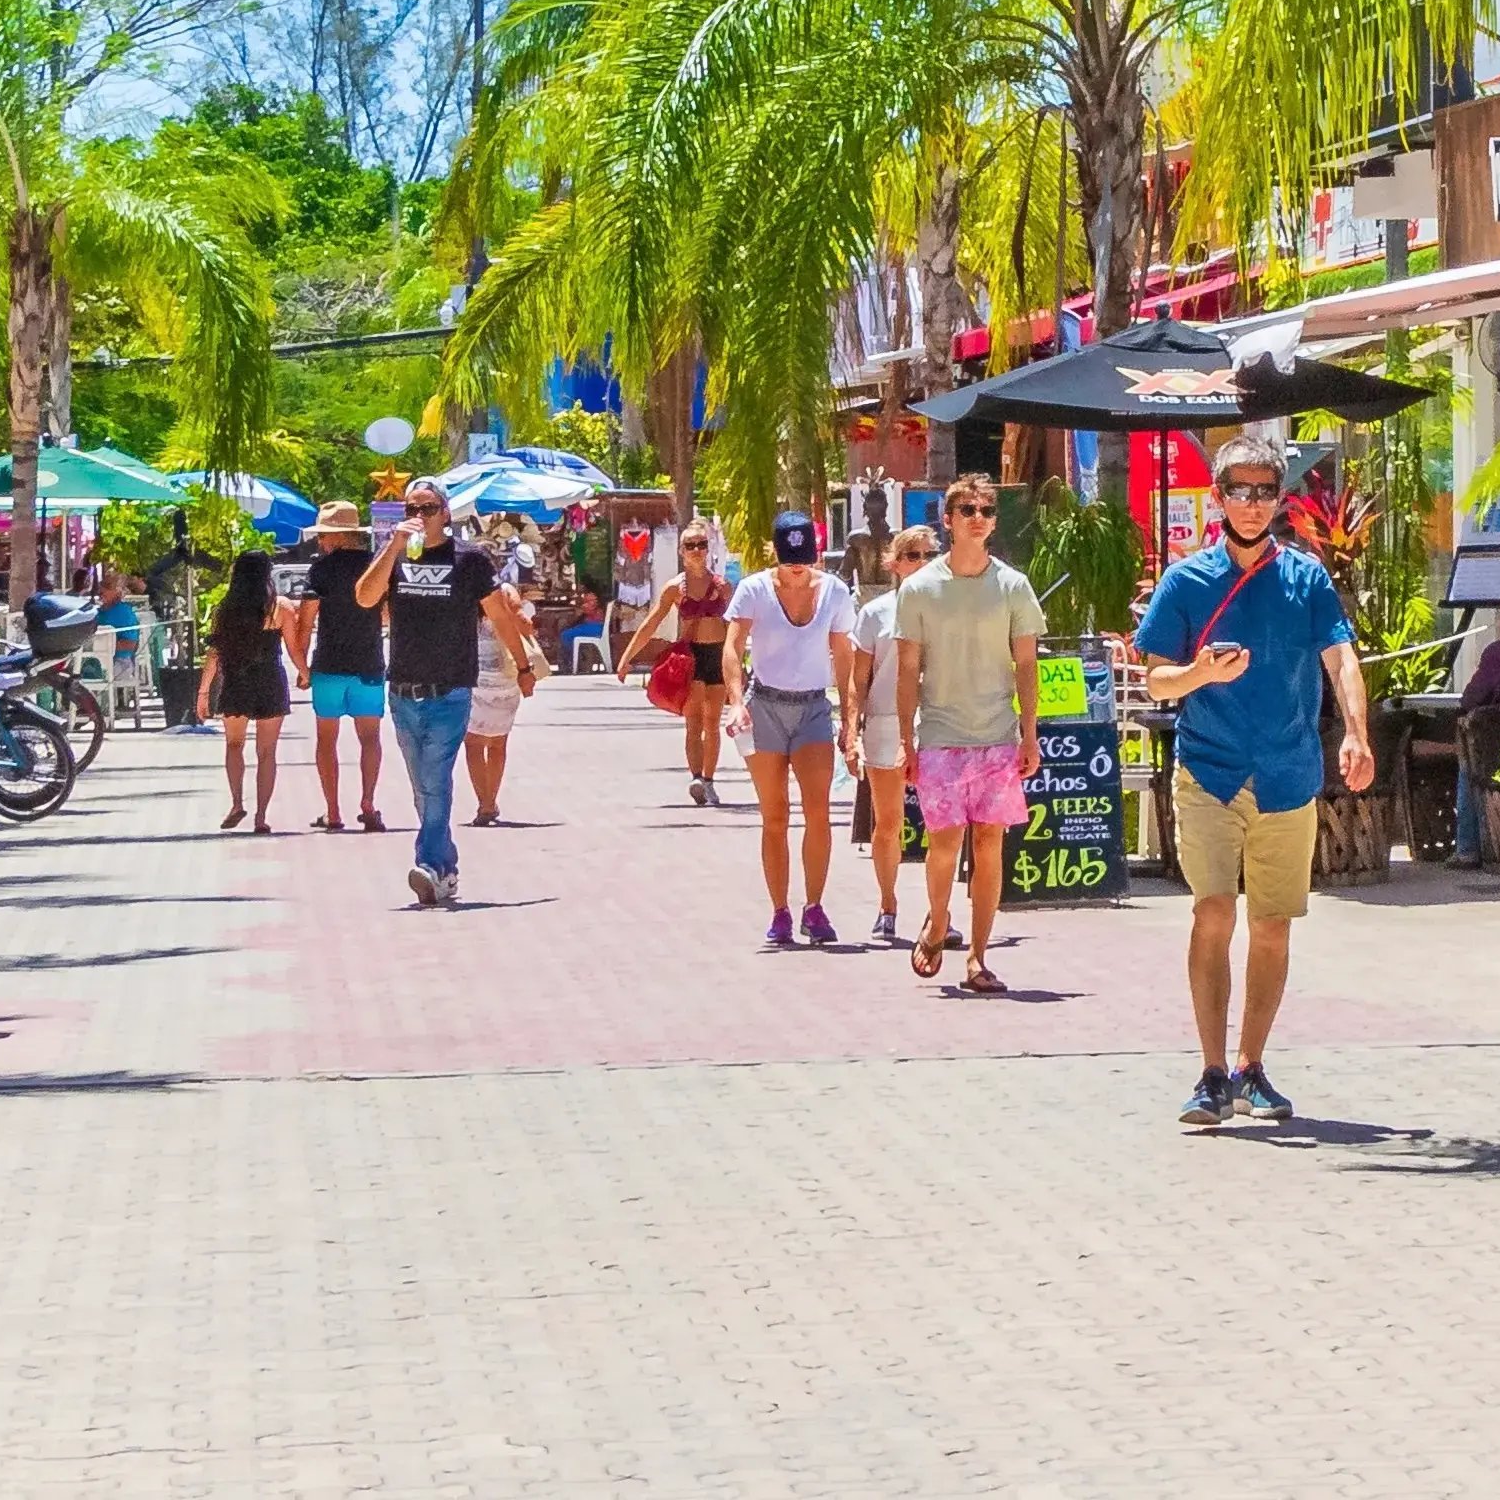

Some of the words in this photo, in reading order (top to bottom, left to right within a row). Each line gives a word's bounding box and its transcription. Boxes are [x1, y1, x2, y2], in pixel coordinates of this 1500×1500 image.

[1184, 395, 1244, 405] EQUI
[1040, 664, 1076, 683] DAY
[1023, 768, 1088, 793] achos
[1023, 803, 1053, 841] 2
[1052, 796, 1113, 816] BEERS
[1011, 846, 1108, 893] $165
